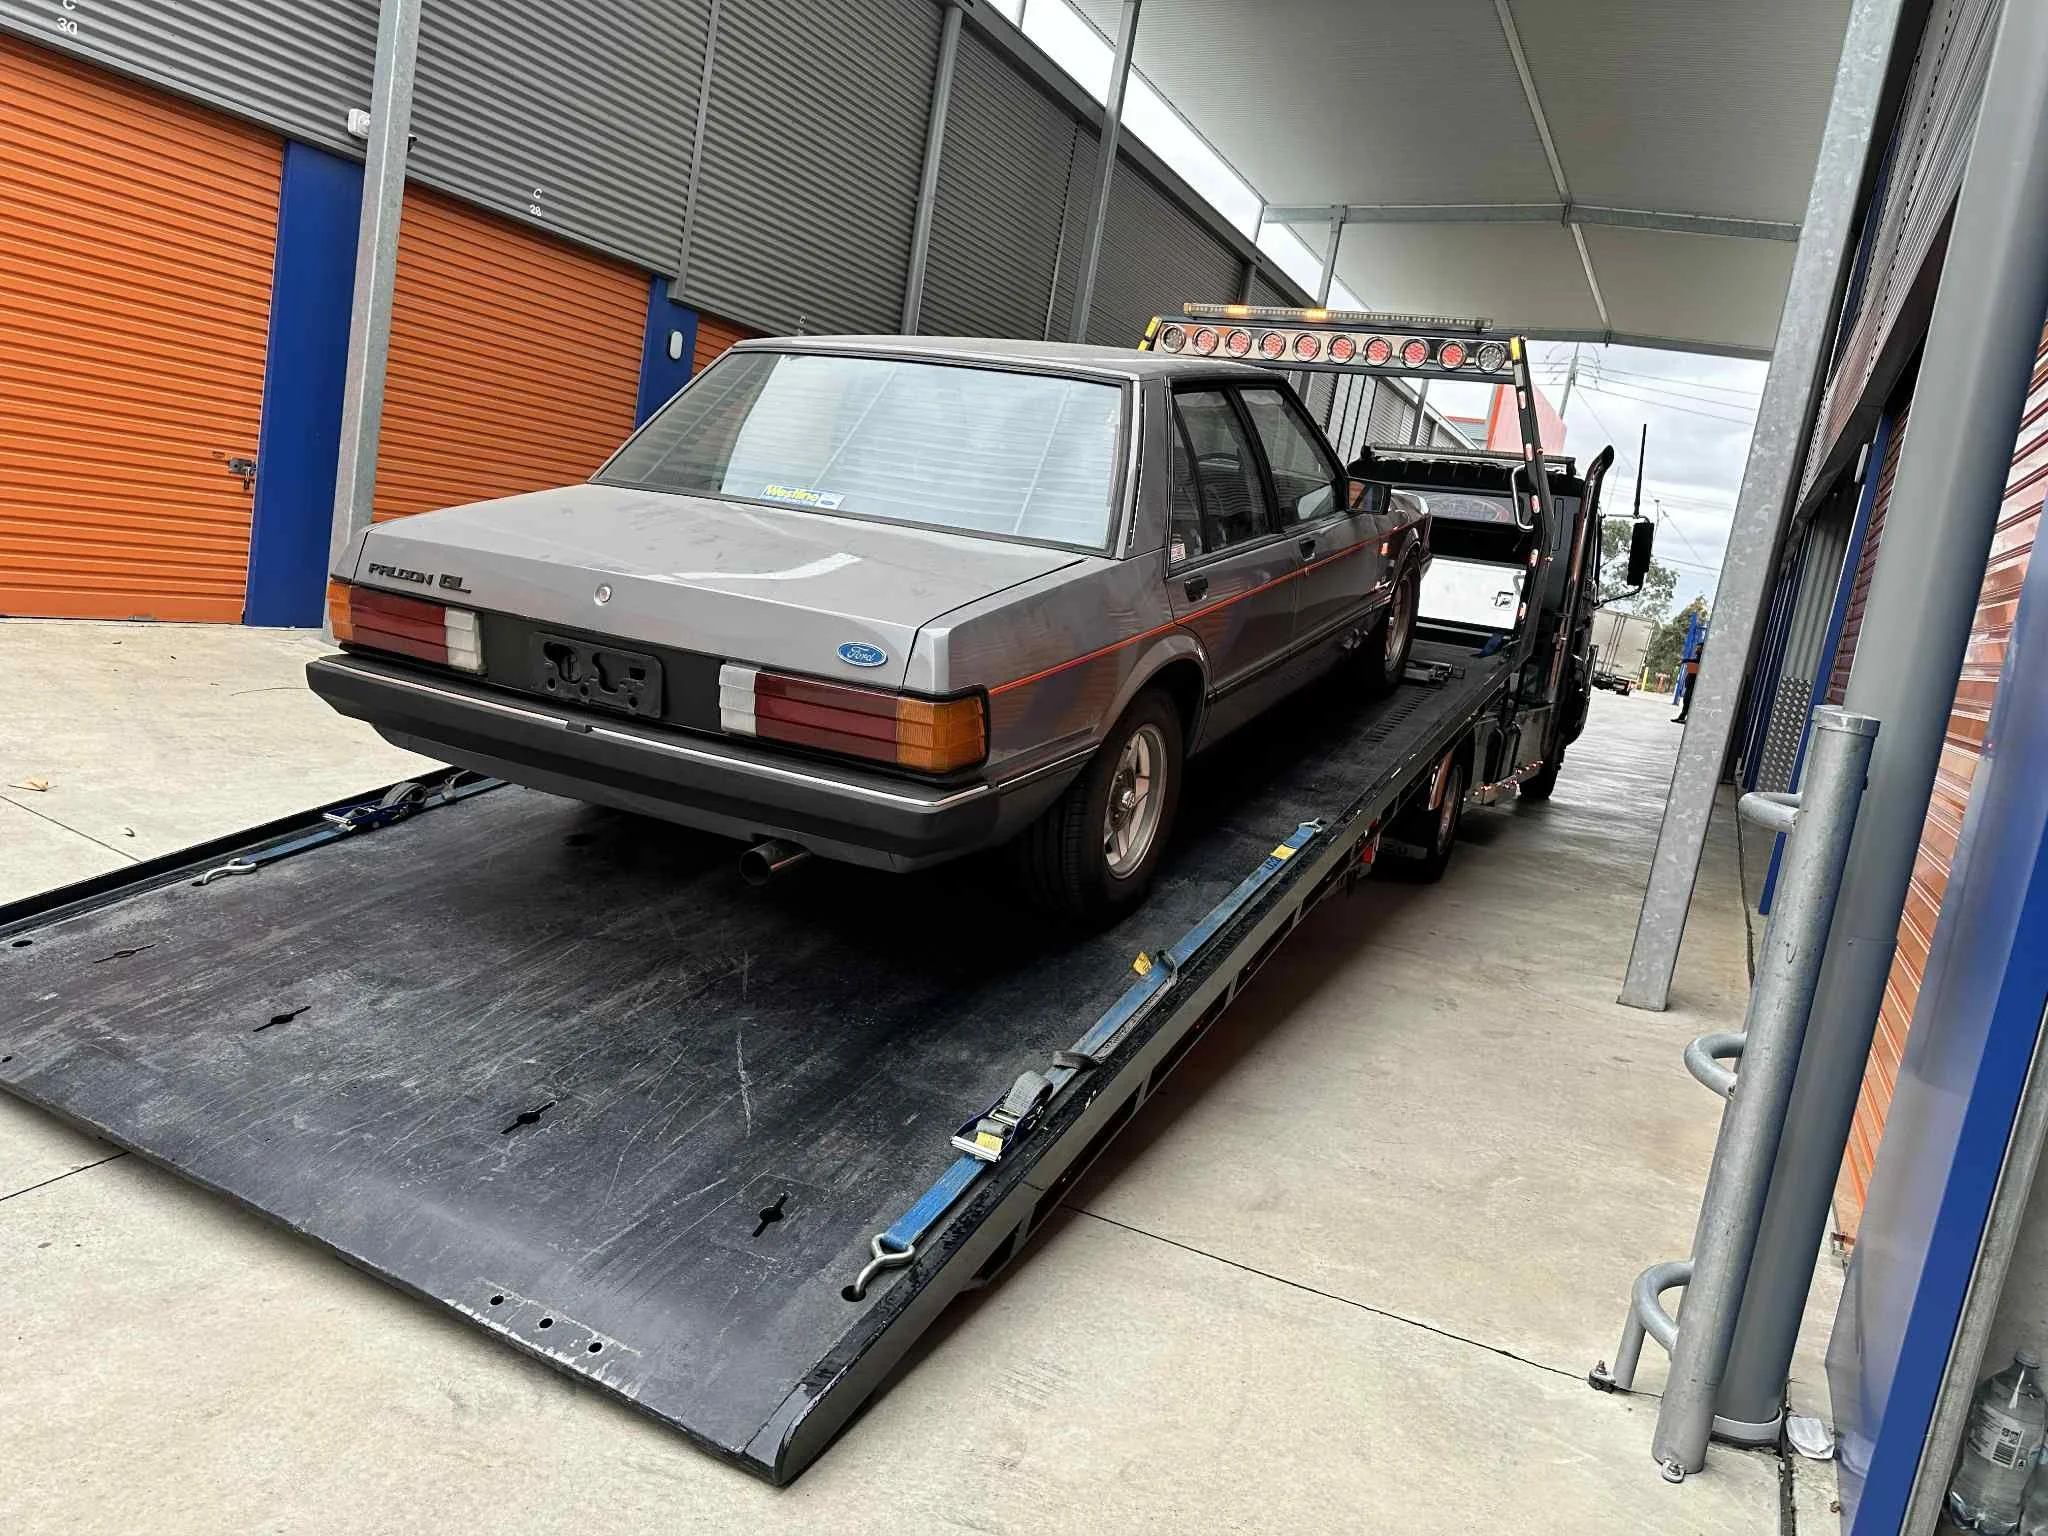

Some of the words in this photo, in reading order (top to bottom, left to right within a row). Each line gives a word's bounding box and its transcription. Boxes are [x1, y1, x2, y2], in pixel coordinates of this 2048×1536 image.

[57, 17, 78, 35] 30
[533, 188, 543, 199] C
[529, 204, 542, 217] 28
[368, 562, 434, 586] FALCON
[438, 573, 472, 594] GL
